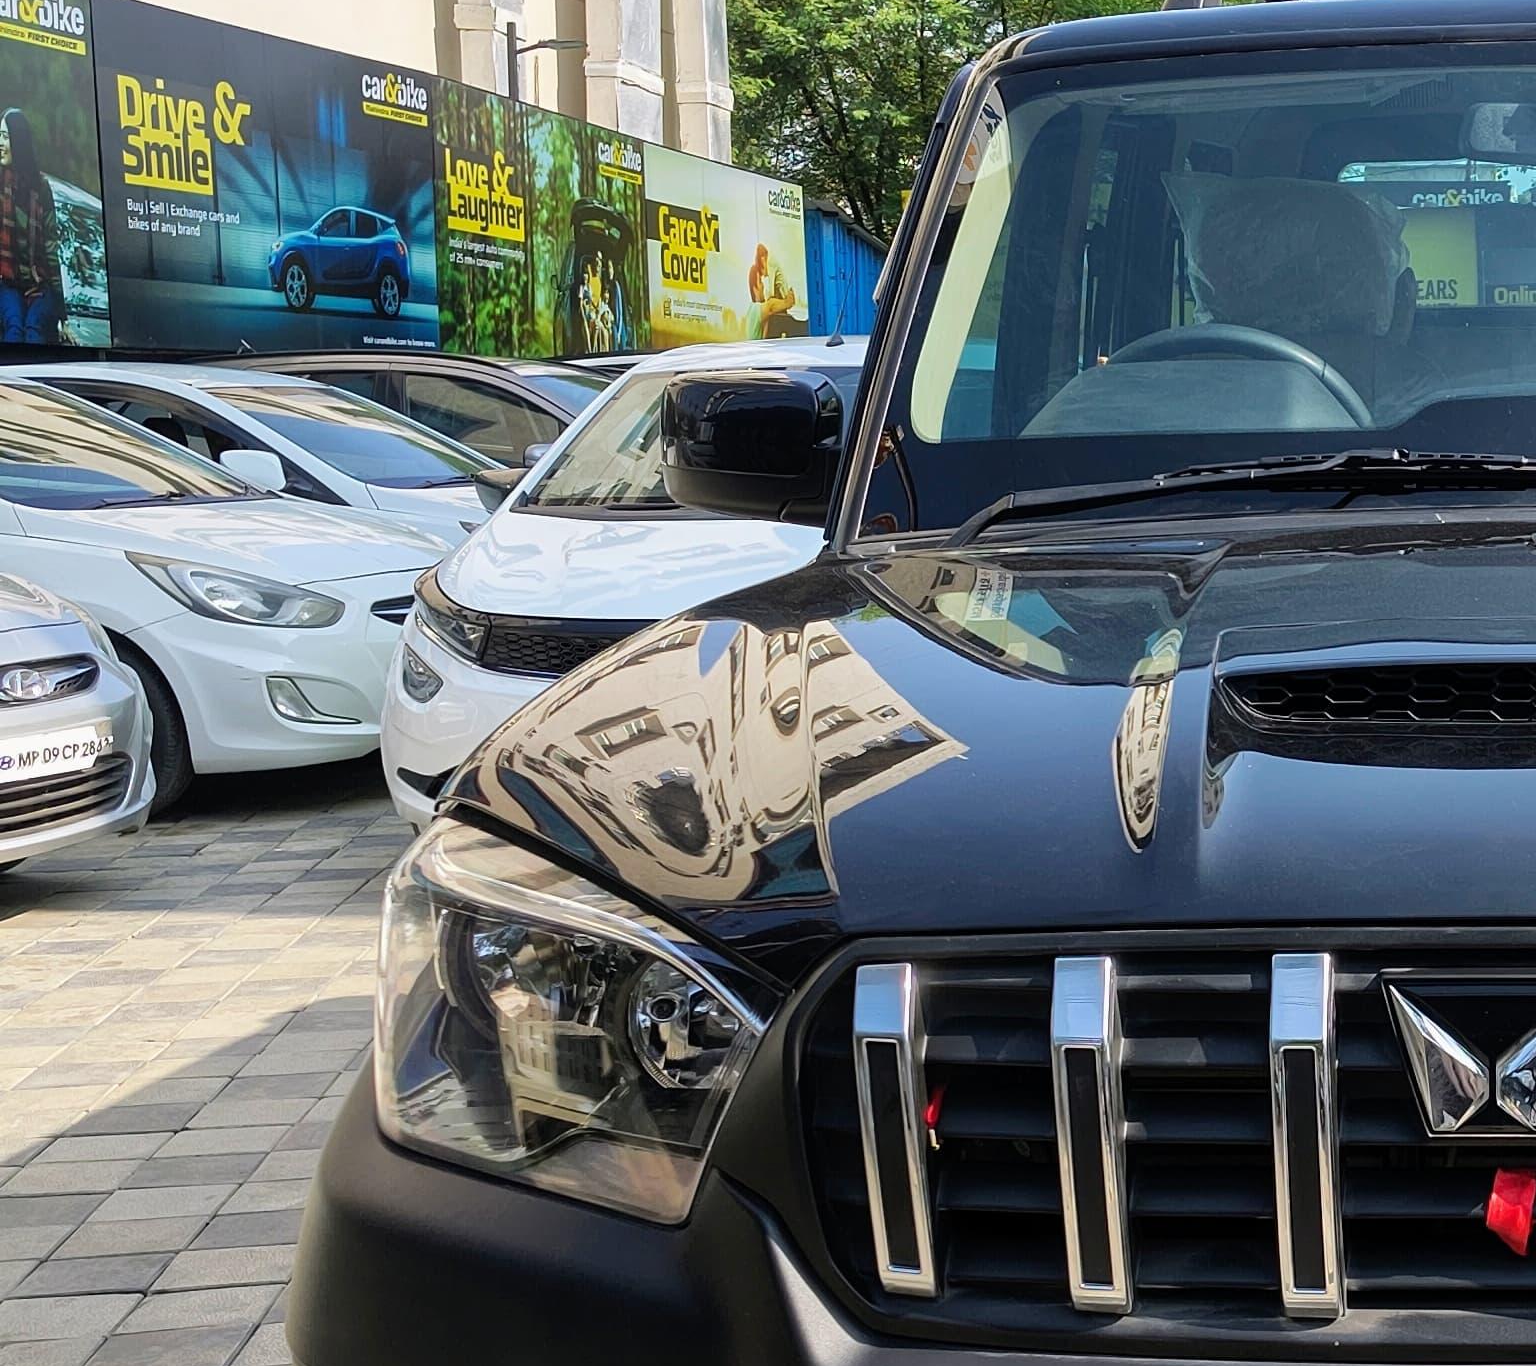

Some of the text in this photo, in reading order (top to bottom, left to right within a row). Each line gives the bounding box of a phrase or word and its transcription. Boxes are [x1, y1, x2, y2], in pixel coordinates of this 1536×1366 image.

[28, 32, 50, 43] FIRST
[50, 38, 78, 50] CHOICE
[117, 75, 251, 146] Drive &
[362, 73, 428, 111] car&bike
[122, 125, 210, 186] Smile
[445, 147, 514, 196] Love &
[598, 139, 642, 172] car&bike
[126, 198, 144, 215] Buy
[149, 201, 165, 215] Sell
[170, 203, 208, 223] Exchange
[208, 211, 225, 223] cars
[225, 212, 240, 224] and
[447, 181, 523, 232] Laughter
[127, 216, 201, 237] bikes of any brand
[658, 205, 719, 251] Care &
[661, 242, 706, 284] Cover
[1416, 278, 1458, 301] EARS
[18, 751, 40, 767] MP
[43, 747, 60, 764] 09
[62, 743, 79, 760] CP
